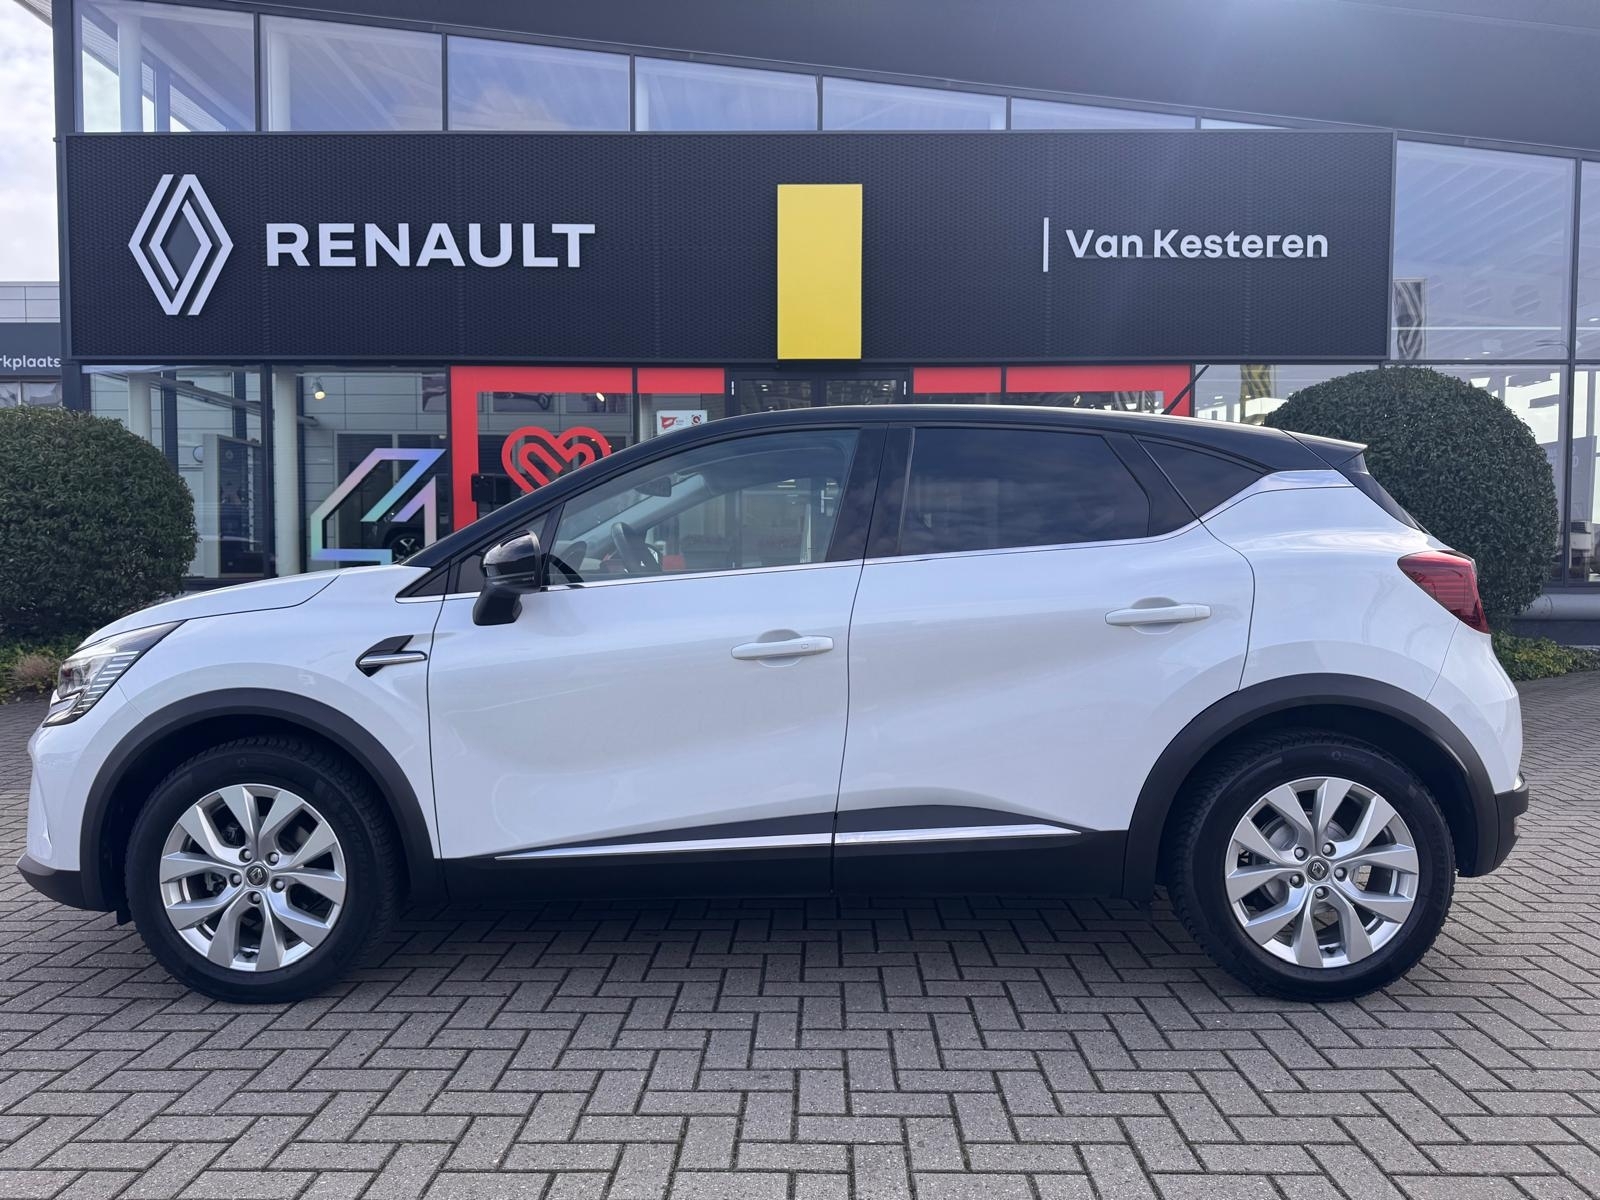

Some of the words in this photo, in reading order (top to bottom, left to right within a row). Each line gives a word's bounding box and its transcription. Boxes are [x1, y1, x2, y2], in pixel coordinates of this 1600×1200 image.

[265, 222, 596, 268] RENAULT
[1065, 229, 1144, 259] Van
[1153, 229, 1329, 259] Kesteren
